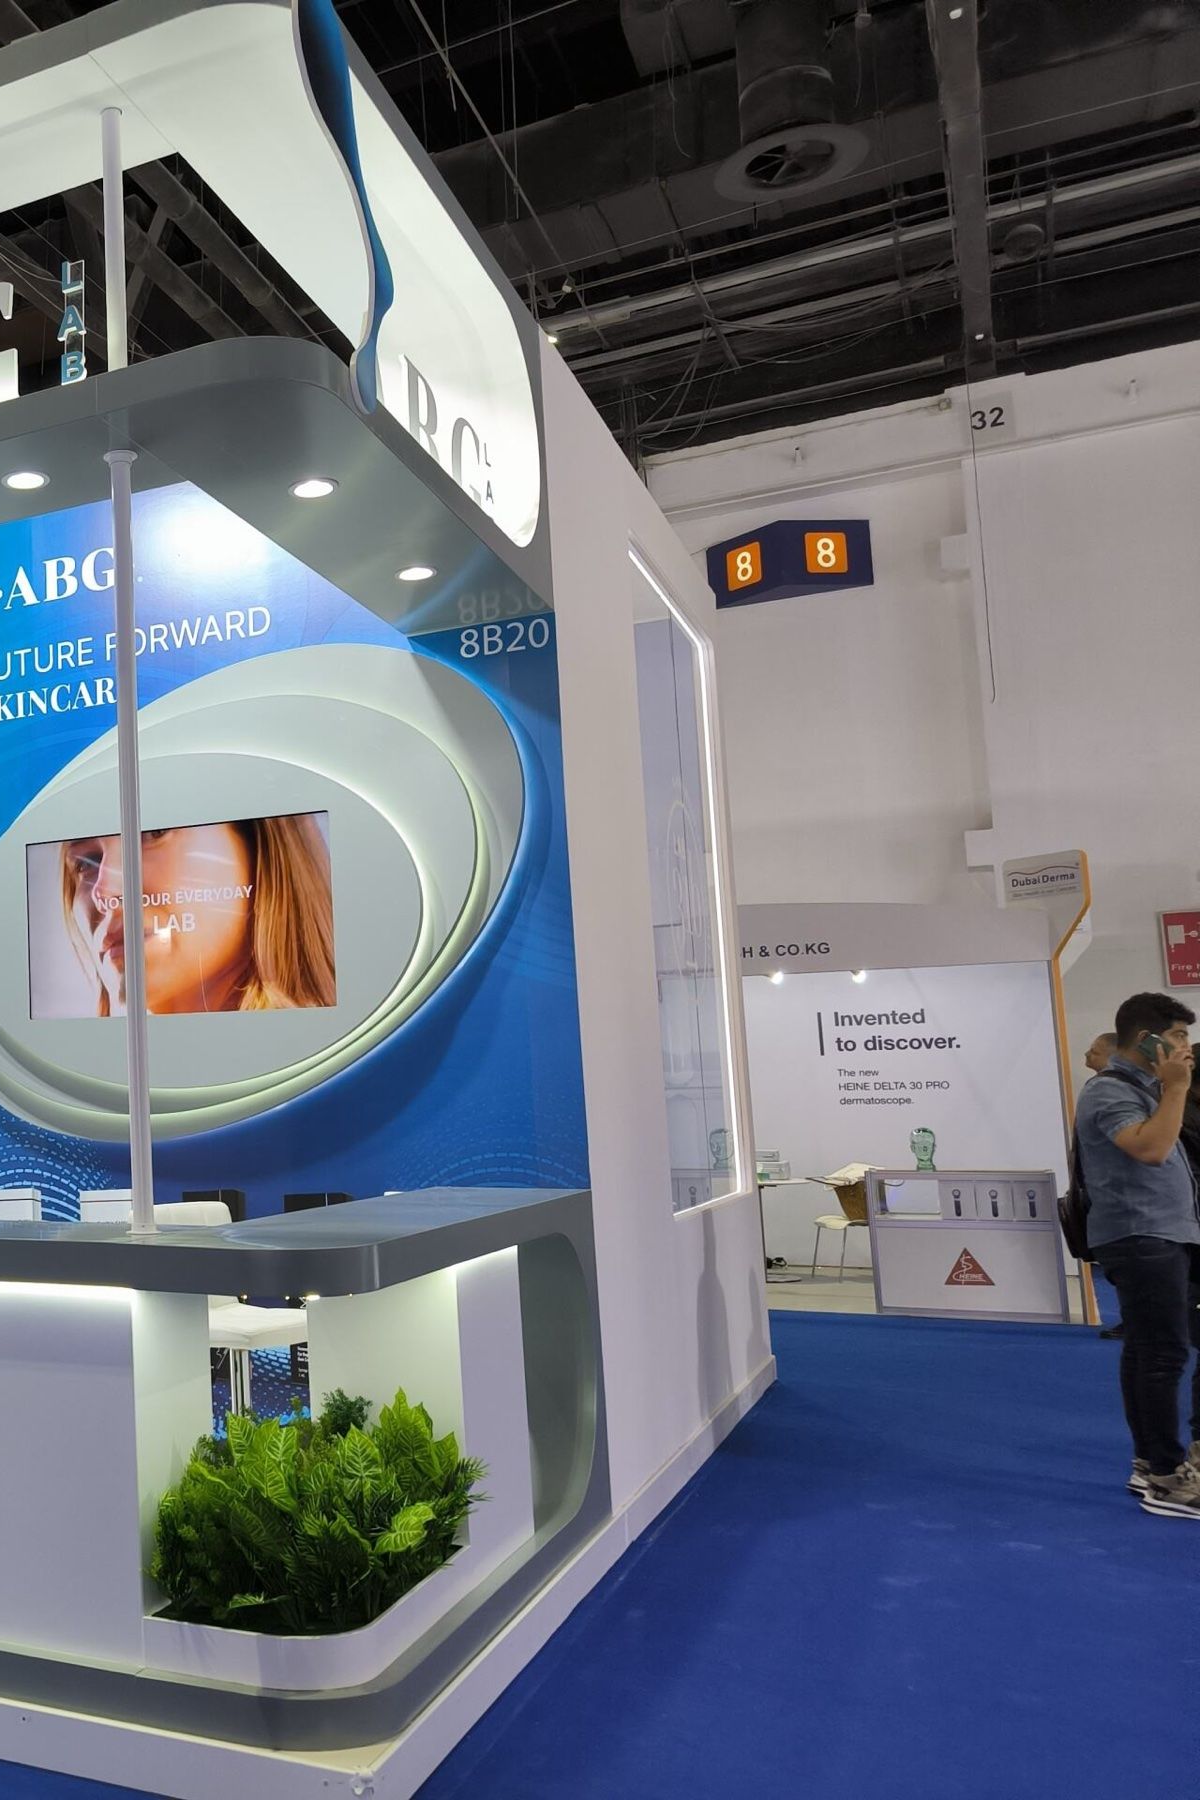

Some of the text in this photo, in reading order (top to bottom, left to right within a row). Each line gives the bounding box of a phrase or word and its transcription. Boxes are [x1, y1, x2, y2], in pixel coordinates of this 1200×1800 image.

[57, 259, 87, 386] LAB
[971, 406, 1005, 430] 32
[816, 537, 836, 568] 8
[736, 551, 753, 581] 8
[4, 547, 116, 610] ABG
[105, 606, 272, 662] FORWARD
[460, 618, 550, 659] 8B20
[140, 892, 171, 907] OUR
[175, 885, 253, 904] EVERYDAY
[153, 912, 196, 935] LAB
[758, 945, 770, 957] &
[834, 1008, 926, 1026] Invented
[835, 1035, 961, 1052] to discover.
[837, 1068, 879, 1077] The new
[838, 1080, 950, 1091] HEINE DELTA 30 PRO
